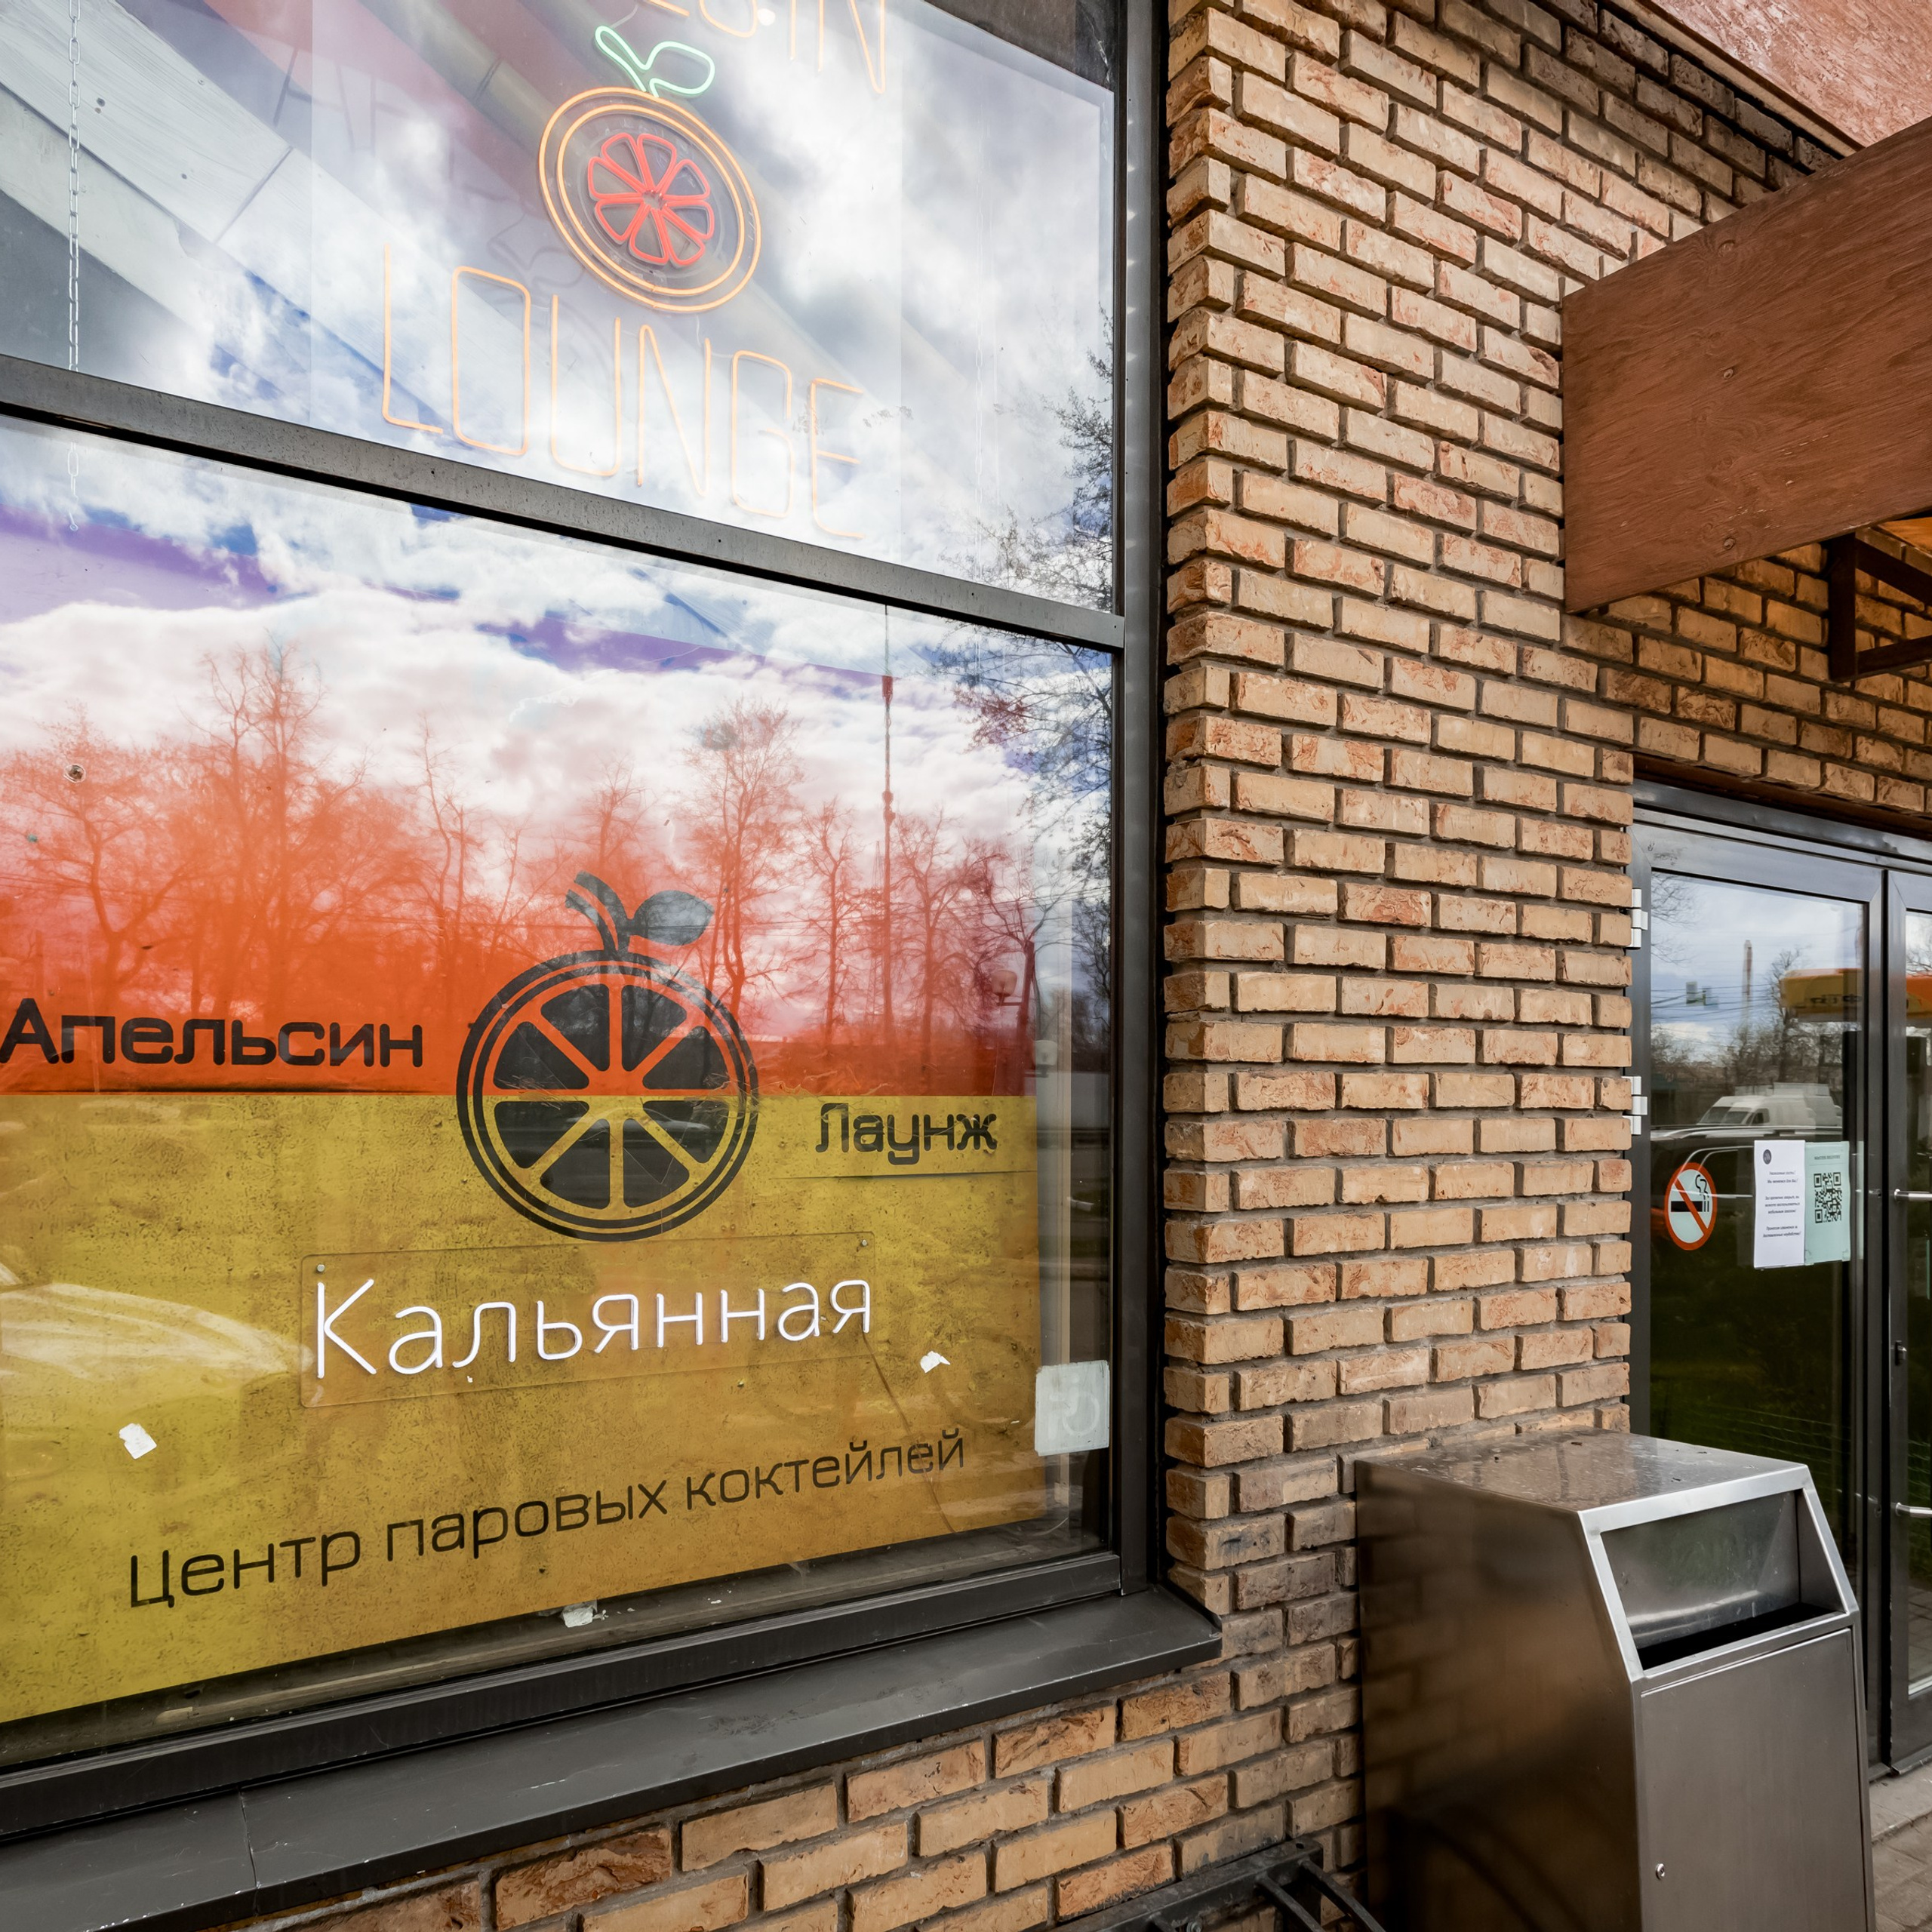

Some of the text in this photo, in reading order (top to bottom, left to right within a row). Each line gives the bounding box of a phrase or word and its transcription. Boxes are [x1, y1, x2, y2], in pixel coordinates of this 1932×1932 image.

[381, 243, 864, 539] LOUNGE
[0, 998, 423, 1068] Апельсин
[816, 1102, 998, 1165] Лаунж
[315, 1278, 872, 1379] Кальянная
[130, 1429, 965, 1608] Центр паровых коктейлей
